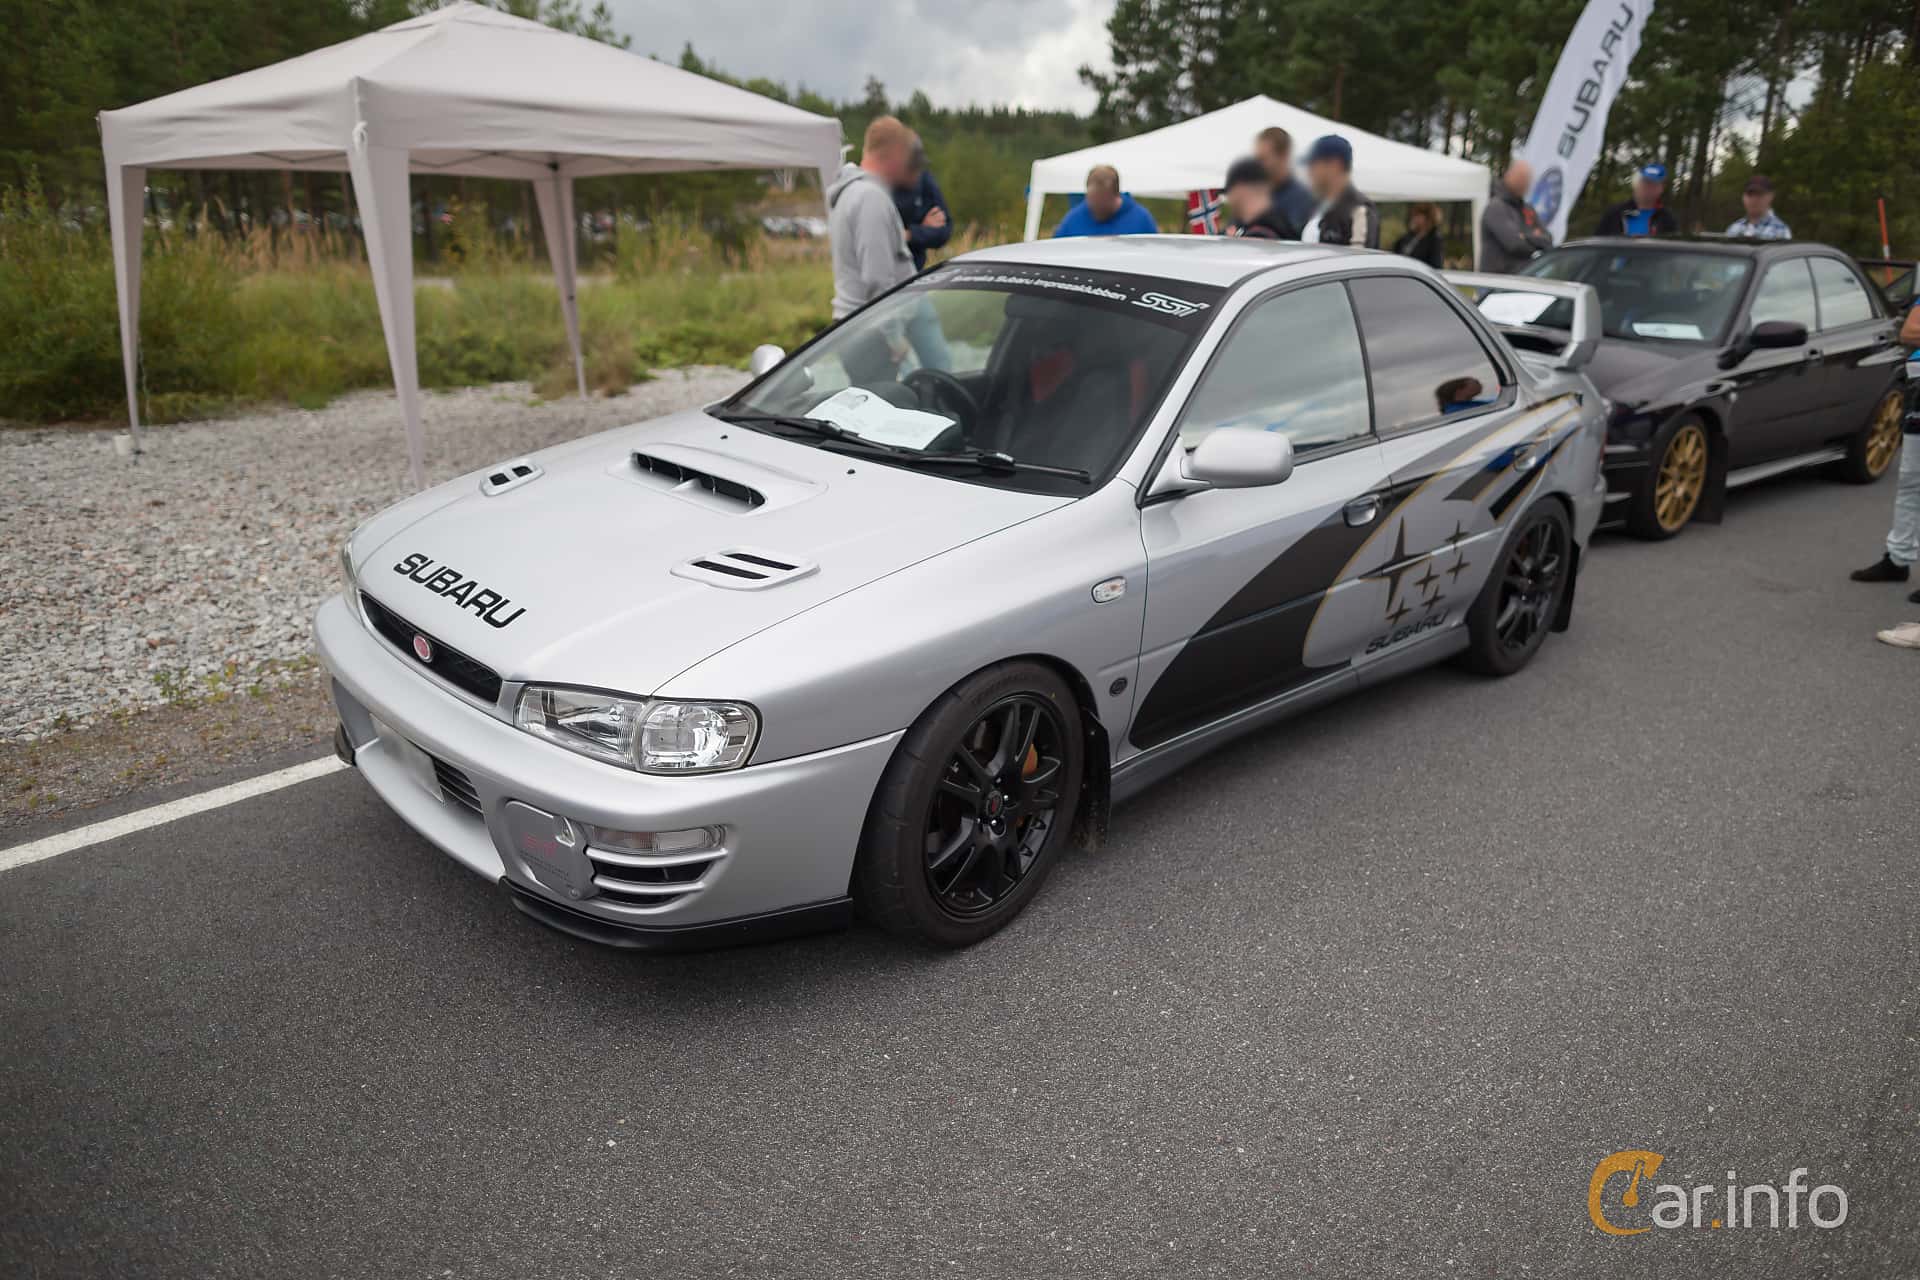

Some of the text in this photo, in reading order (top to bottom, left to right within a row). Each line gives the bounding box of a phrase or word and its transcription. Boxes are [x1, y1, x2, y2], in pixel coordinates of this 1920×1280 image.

[1558, 2, 1634, 160] SUBARU
[393, 553, 527, 628] SUBARU
[1365, 608, 1450, 655] SUBARU
